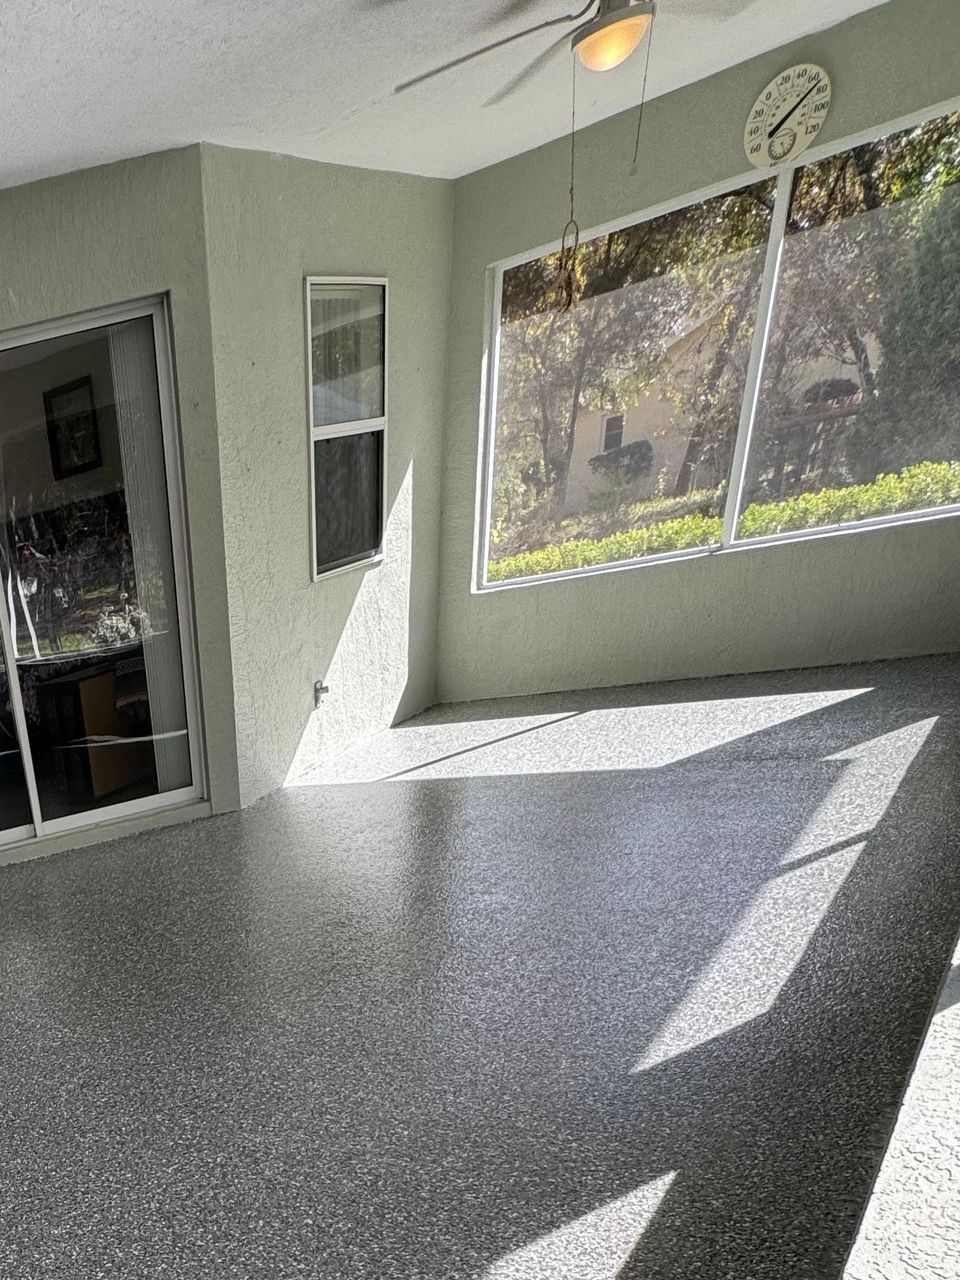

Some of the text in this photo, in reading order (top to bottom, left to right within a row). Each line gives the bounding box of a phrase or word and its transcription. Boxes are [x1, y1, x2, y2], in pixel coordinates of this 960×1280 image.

[779, 74, 791, 86] 20
[795, 68, 807, 80] 40
[807, 72, 820, 83] 60
[816, 84, 828, 95] 80
[765, 91, 772, 101] 0
[813, 101, 829, 113] 100
[752, 108, 764, 120] 20
[805, 123, 820, 135] 120
[750, 143, 761, 154] 60
